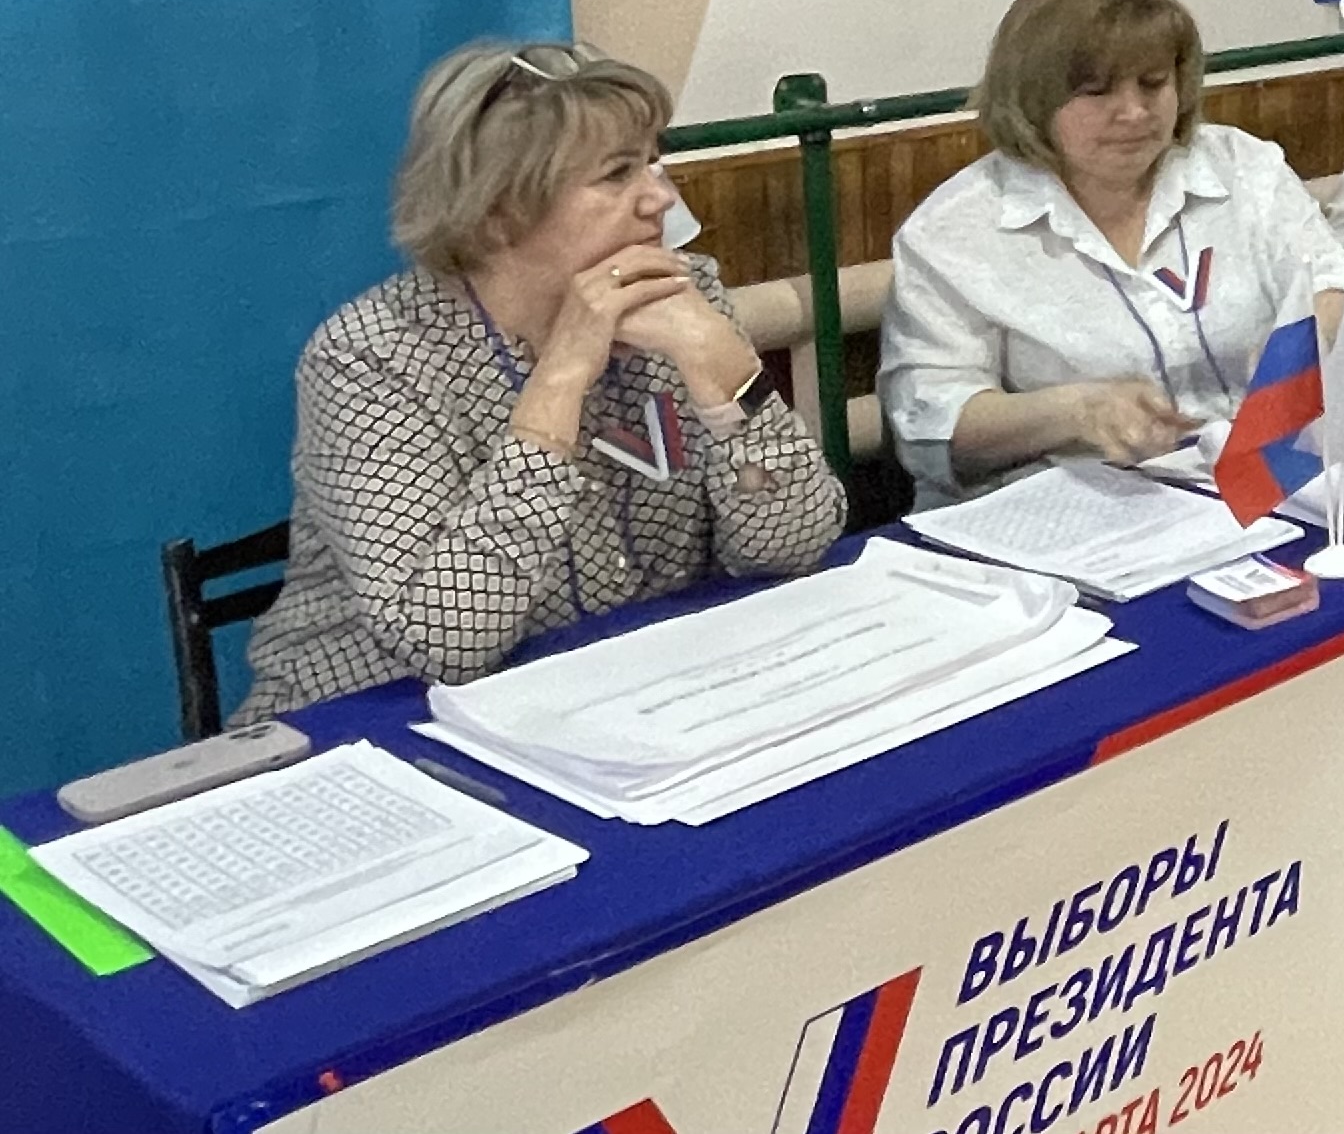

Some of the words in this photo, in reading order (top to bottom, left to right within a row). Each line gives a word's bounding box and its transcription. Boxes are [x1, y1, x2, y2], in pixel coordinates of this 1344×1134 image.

[926, 860, 1303, 1110] ПРЕЗИДЕНТА
[955, 818, 1230, 1007] ВЫБОРЫ
[928, 1012, 1158, 1134] ОССИИ
[1168, 1028, 1264, 1128] 2024
